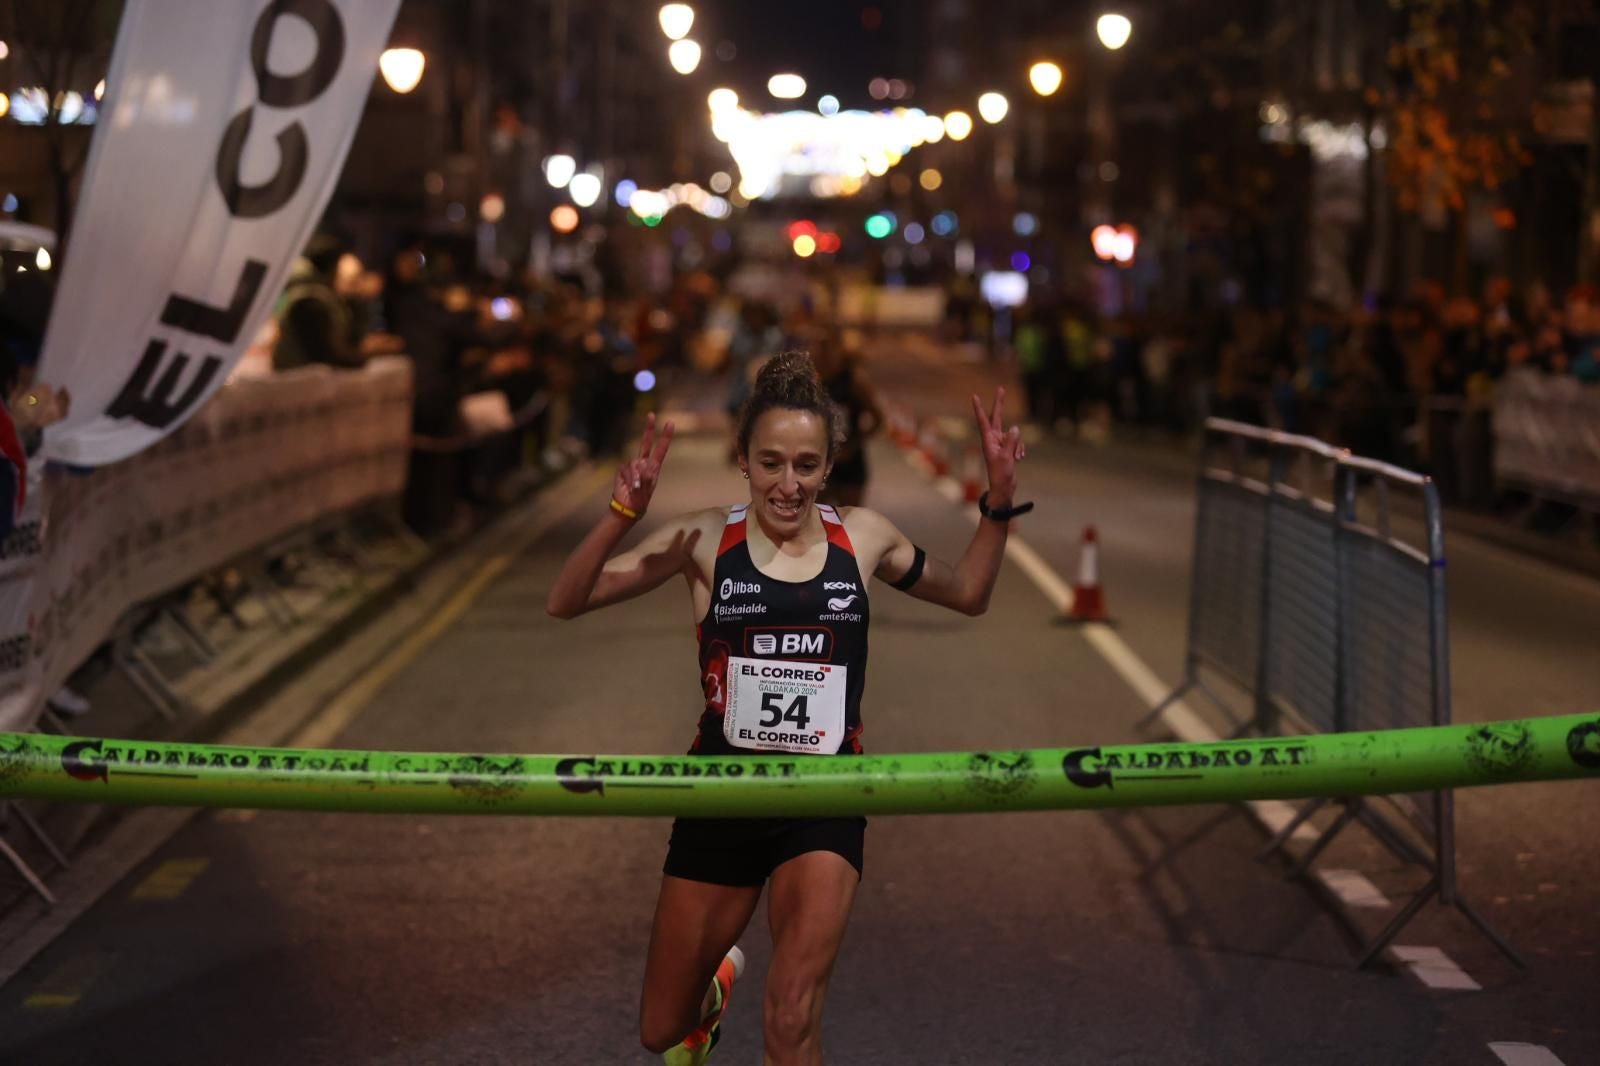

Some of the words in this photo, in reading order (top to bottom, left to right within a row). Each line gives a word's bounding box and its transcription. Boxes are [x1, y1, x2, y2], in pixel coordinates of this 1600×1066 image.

[106, 258, 269, 429] EL
[720, 577, 761, 601] Bilbao
[719, 603, 767, 616] Bizkaialde
[819, 613, 862, 623] emteSPORT
[781, 634, 824, 654] BM
[741, 665, 758, 676] EL
[761, 667, 825, 681] CORREO
[758, 684, 800, 695] GALDAKAO
[759, 692, 810, 730] 54
[738, 729, 755, 740] EL
[758, 731, 820, 745] CORREO
